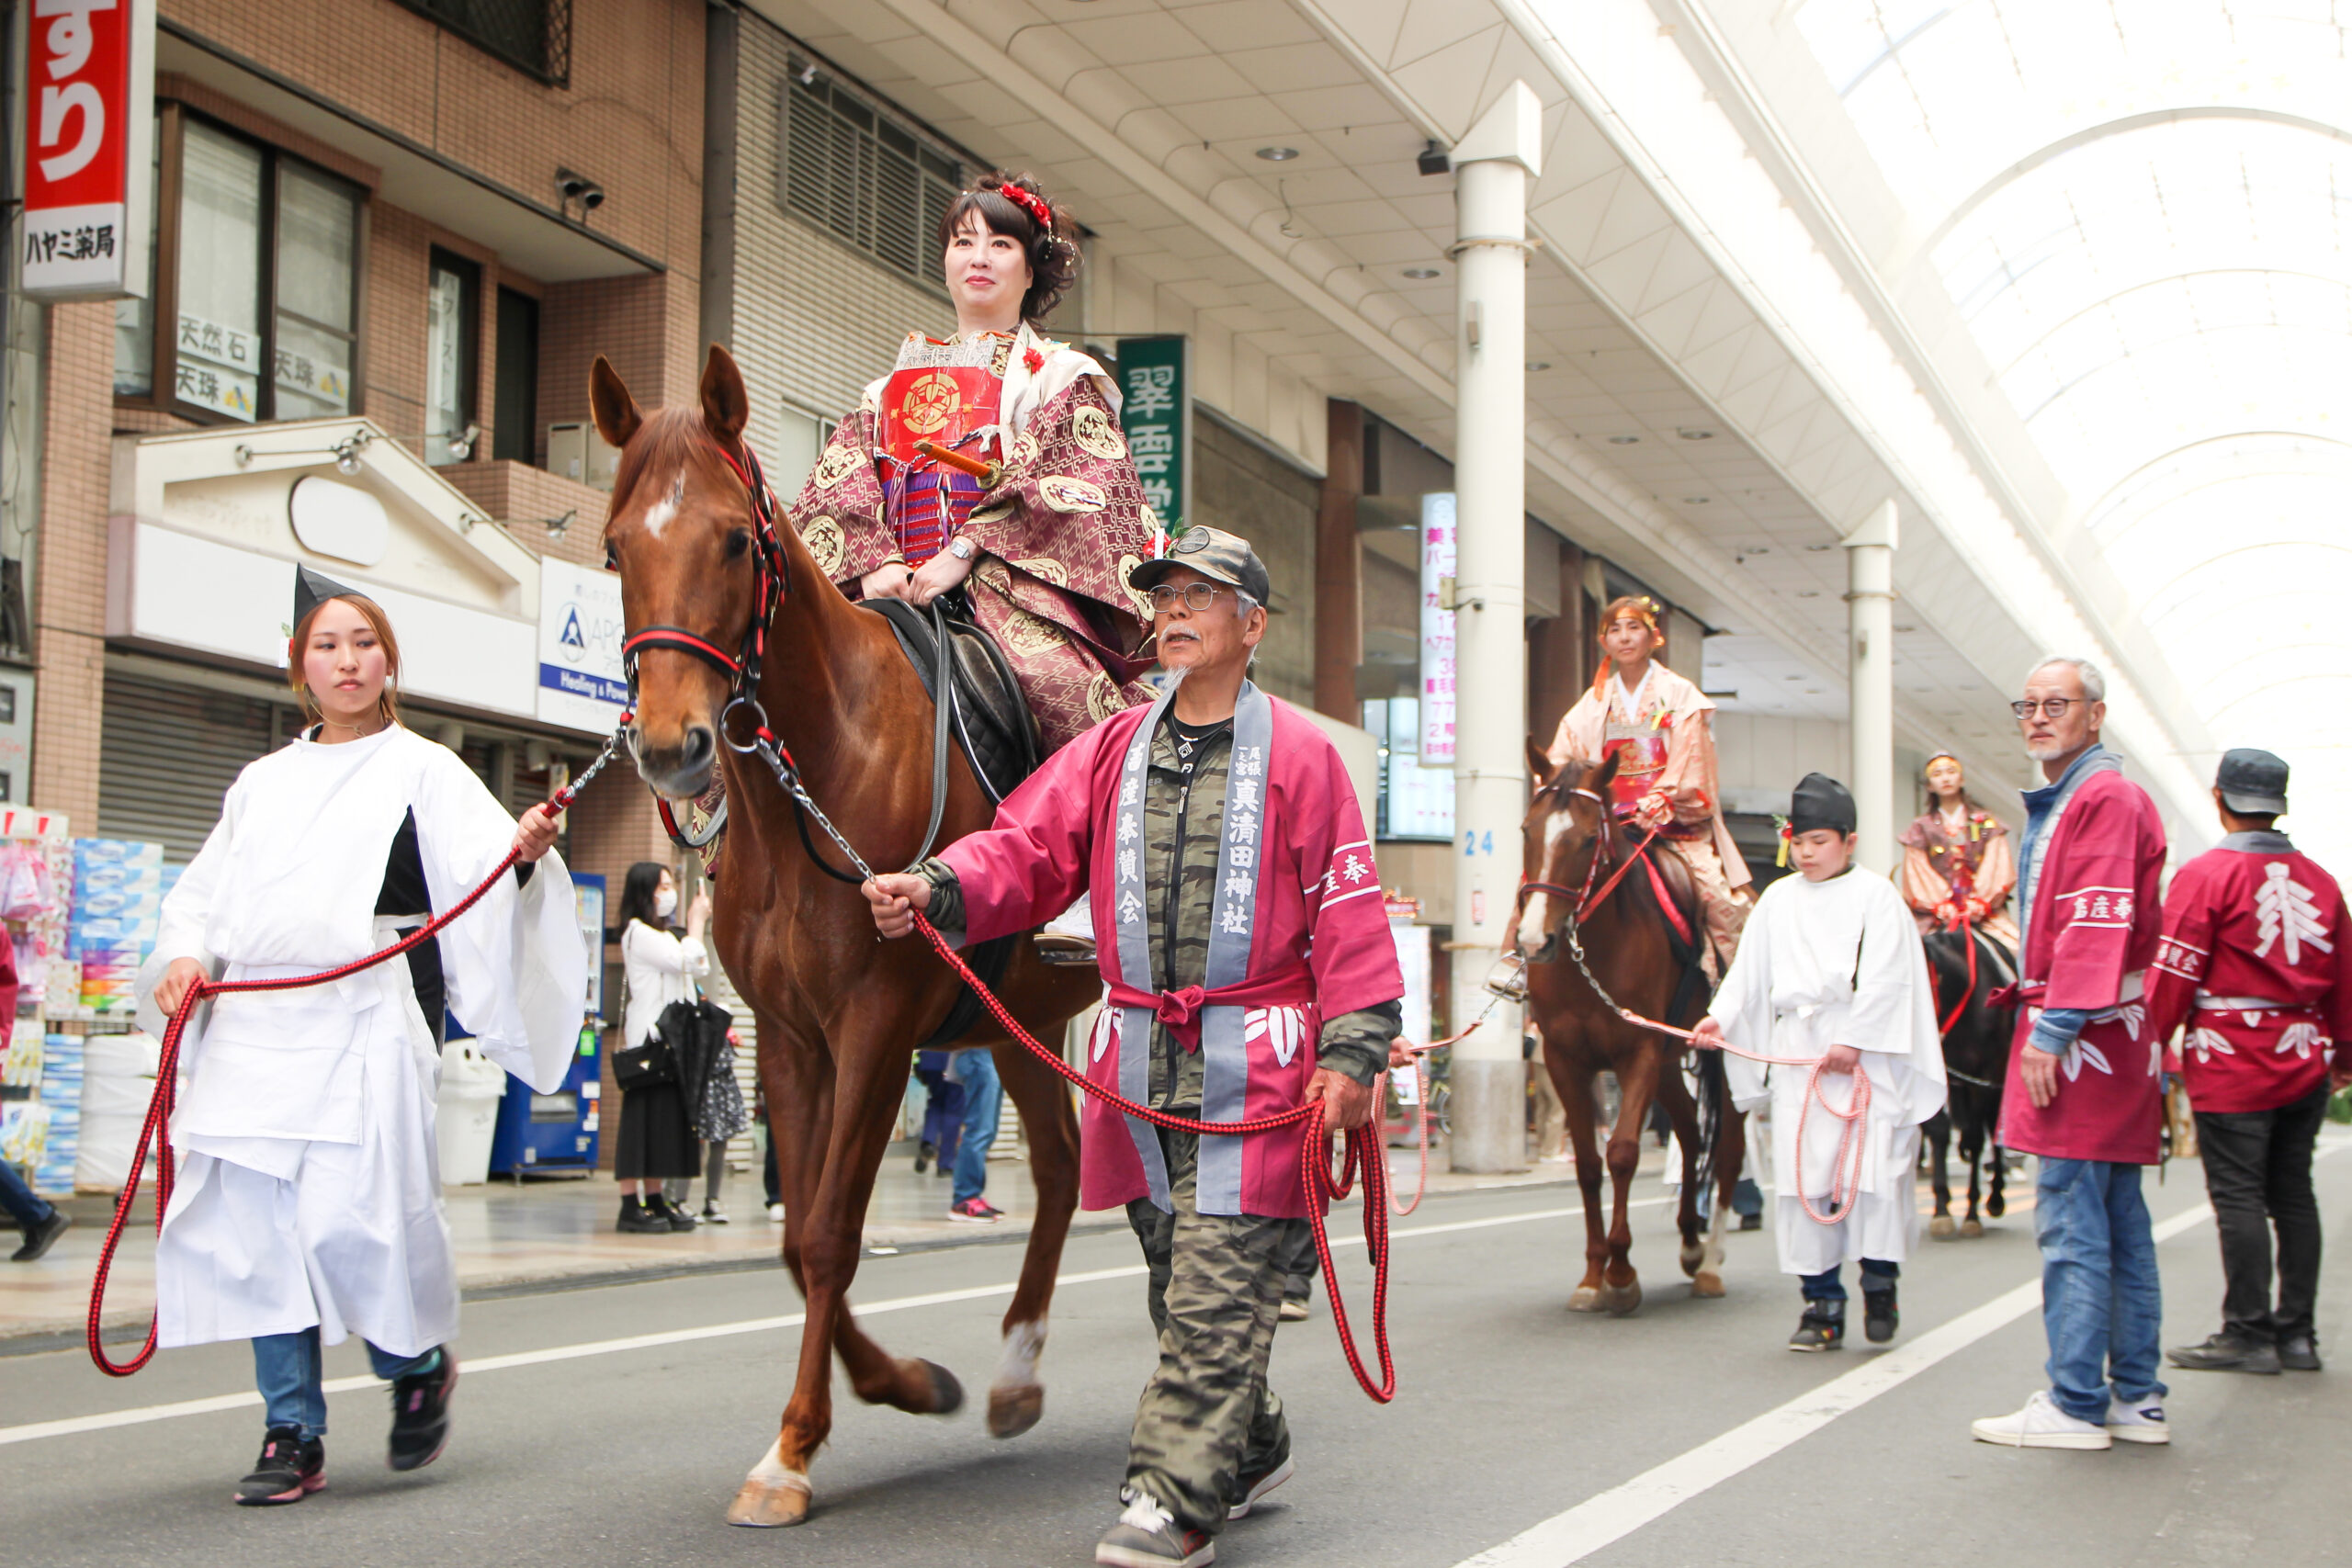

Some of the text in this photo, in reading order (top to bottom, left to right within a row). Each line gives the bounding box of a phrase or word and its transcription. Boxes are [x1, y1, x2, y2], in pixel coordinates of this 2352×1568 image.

[26, 224, 114, 265] ハヤミ薬局
[180, 317, 248, 363] 天然石
[177, 364, 220, 405] 天珠
[560, 671, 597, 699] Healing
[1247, 746, 1261, 777] 尾張
[1220, 778, 1260, 935] 真清田神社
[1465, 829, 1493, 856] 24
